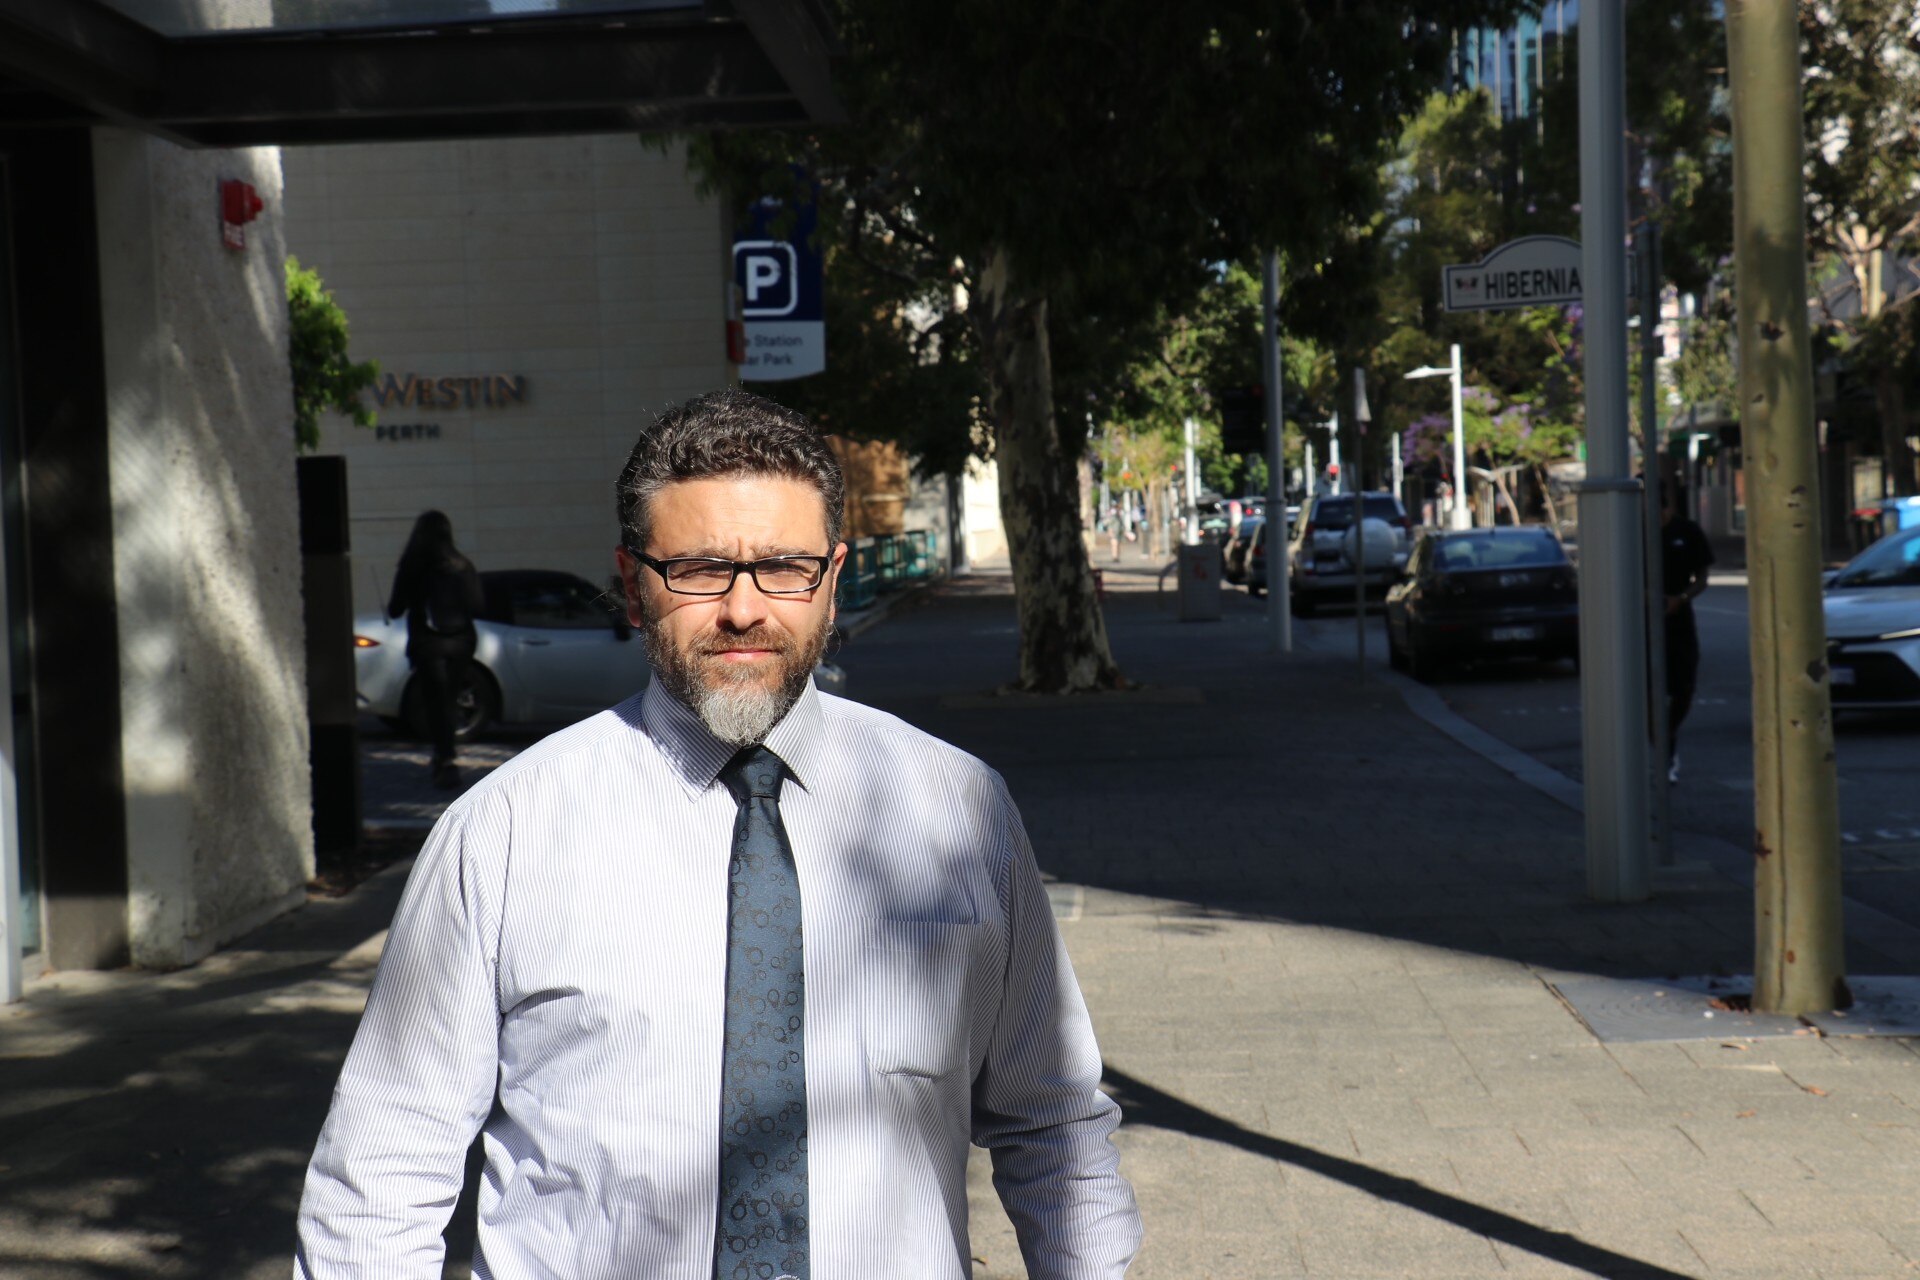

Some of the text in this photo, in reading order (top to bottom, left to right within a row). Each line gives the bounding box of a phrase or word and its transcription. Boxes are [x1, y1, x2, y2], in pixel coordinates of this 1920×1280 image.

[746, 256, 781, 301] P
[1485, 267, 1582, 299] HIBERNIA
[754, 334, 803, 347] Station
[763, 352, 793, 365] Park
[371, 373, 528, 409] WESTIN
[376, 424, 441, 440] PERTH
